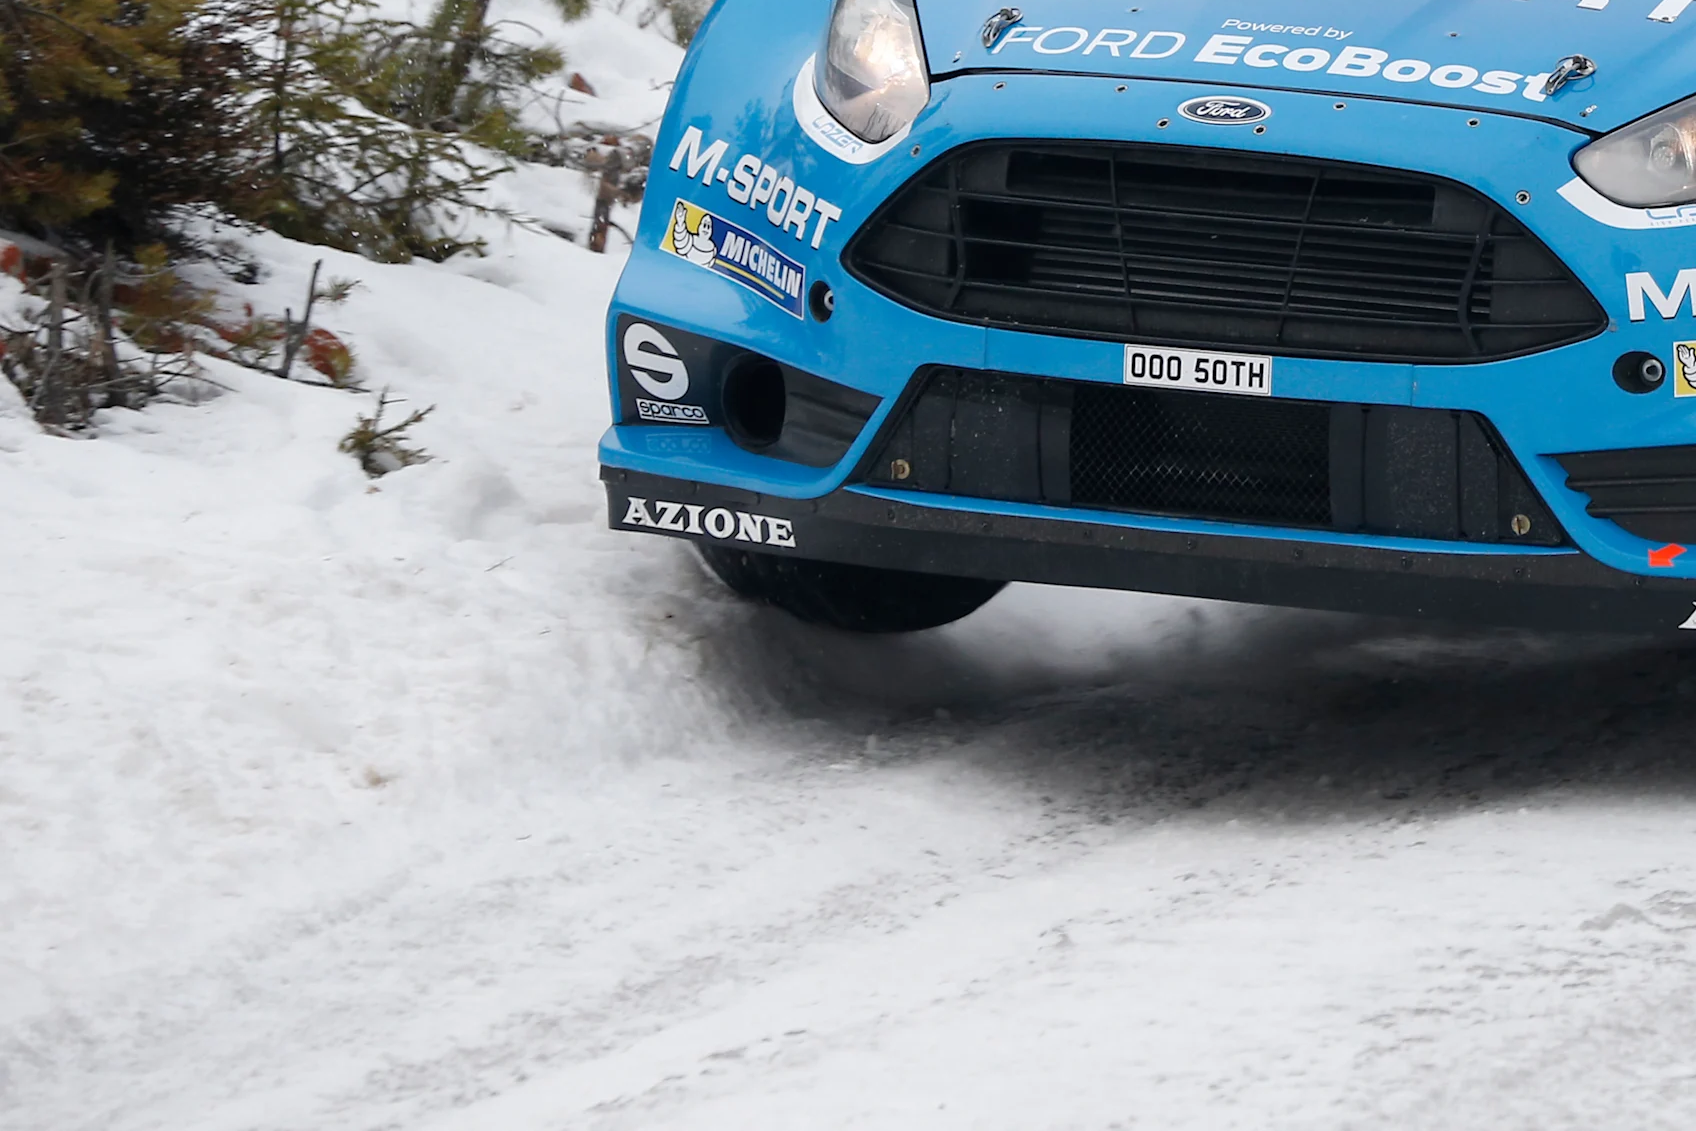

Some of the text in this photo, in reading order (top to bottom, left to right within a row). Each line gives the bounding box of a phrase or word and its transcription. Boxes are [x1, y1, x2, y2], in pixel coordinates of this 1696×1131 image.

[991, 26, 1186, 59] FORD
[1221, 19, 1354, 41] Powered by
[1193, 33, 1549, 103] EcoBoost
[1196, 100, 1251, 119] Ford
[669, 125, 843, 250] M-SPORT
[719, 230, 802, 299] MICHELIN
[639, 400, 705, 419] sparco
[622, 496, 797, 548] AZIONE
